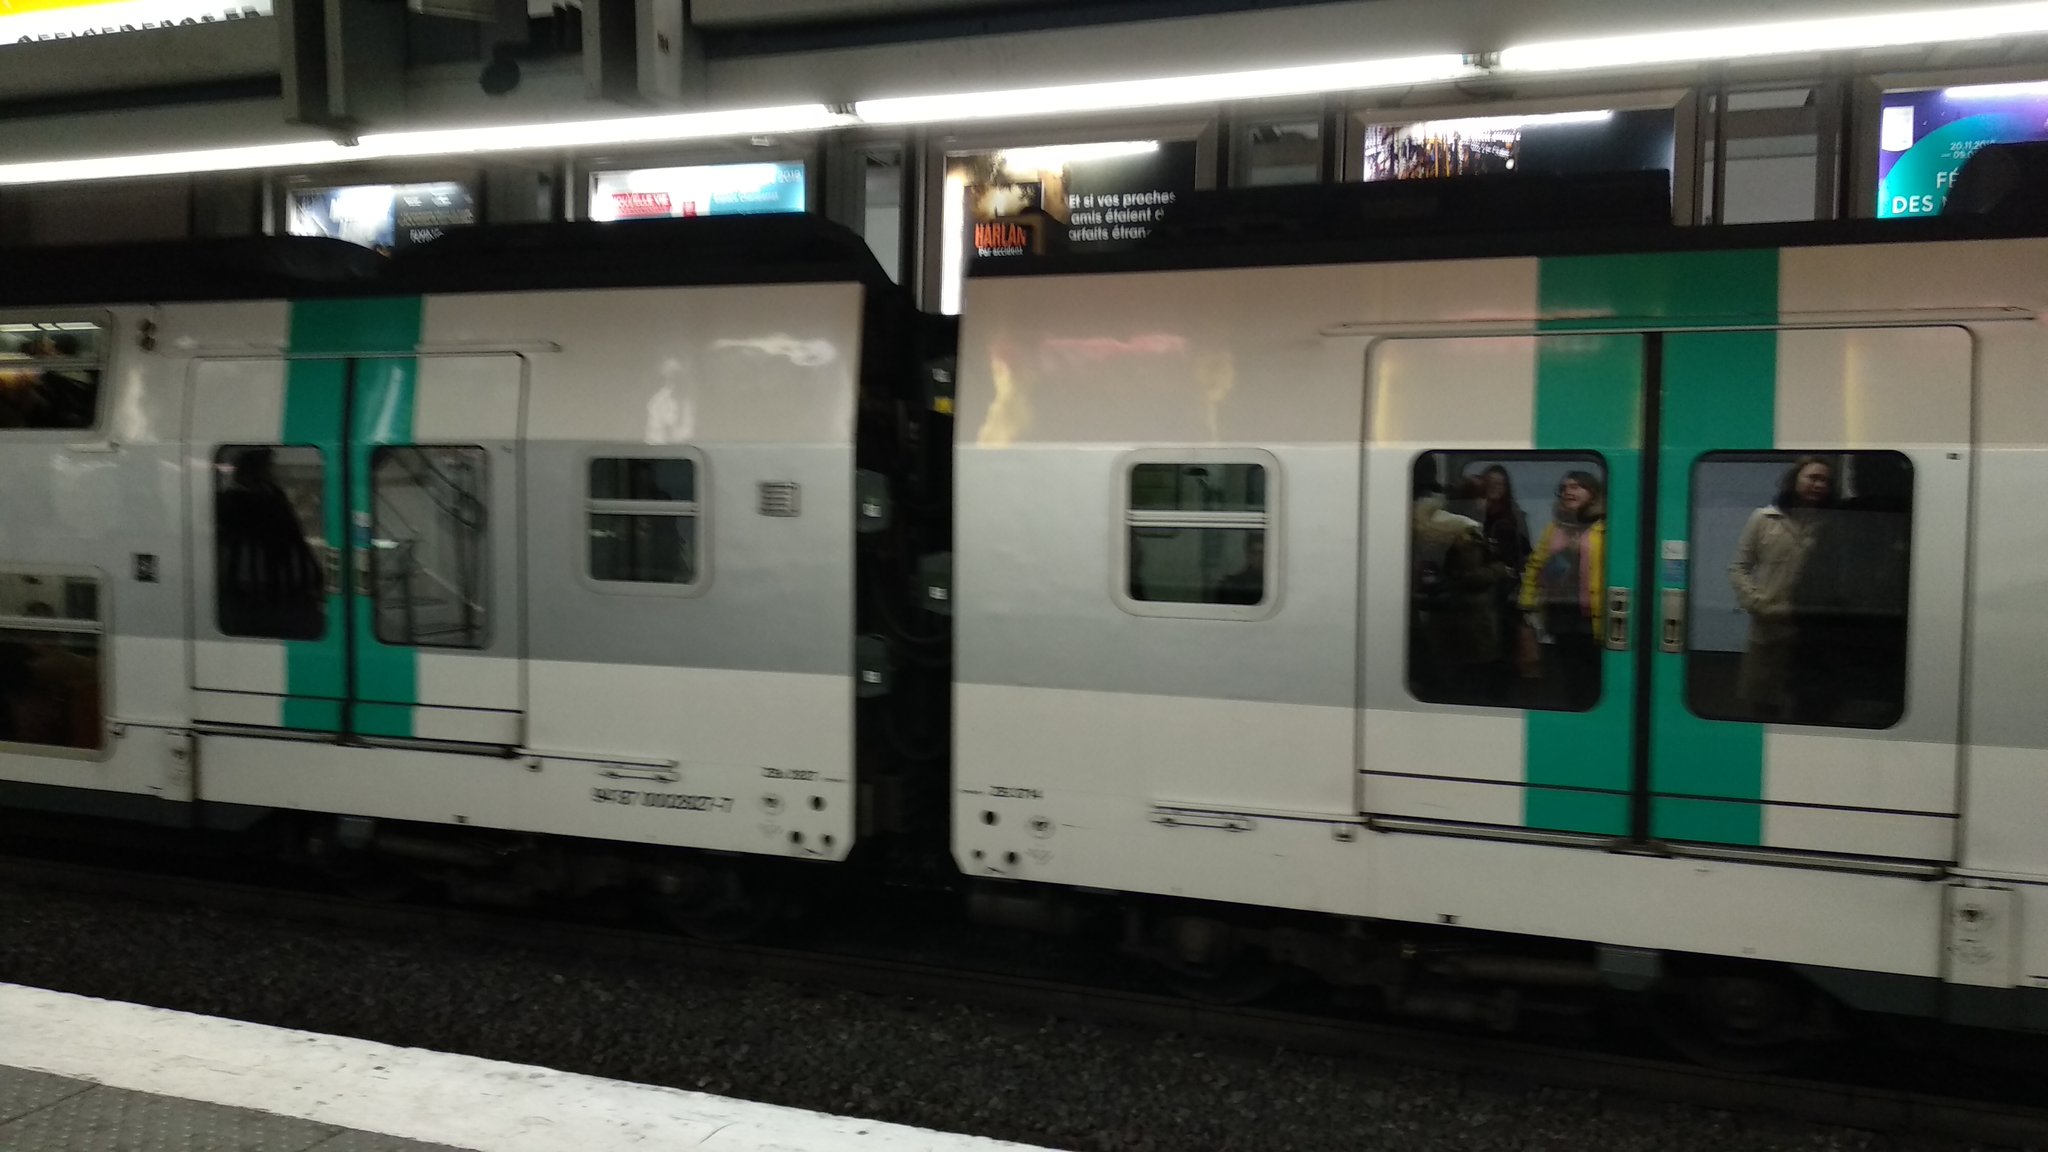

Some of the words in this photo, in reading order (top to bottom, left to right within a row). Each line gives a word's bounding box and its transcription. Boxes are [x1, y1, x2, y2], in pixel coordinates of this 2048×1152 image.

[1069, 194, 1080, 209] Et
[1083, 193, 1094, 208] si
[1097, 194, 1120, 208] vos
[1122, 189, 1176, 208] proches
[1891, 195, 1934, 214] DES
[1071, 209, 1102, 225] amis
[1105, 207, 1152, 224] étaient
[974, 223, 1026, 248] HARLAN
[1111, 224, 1152, 240] étran
